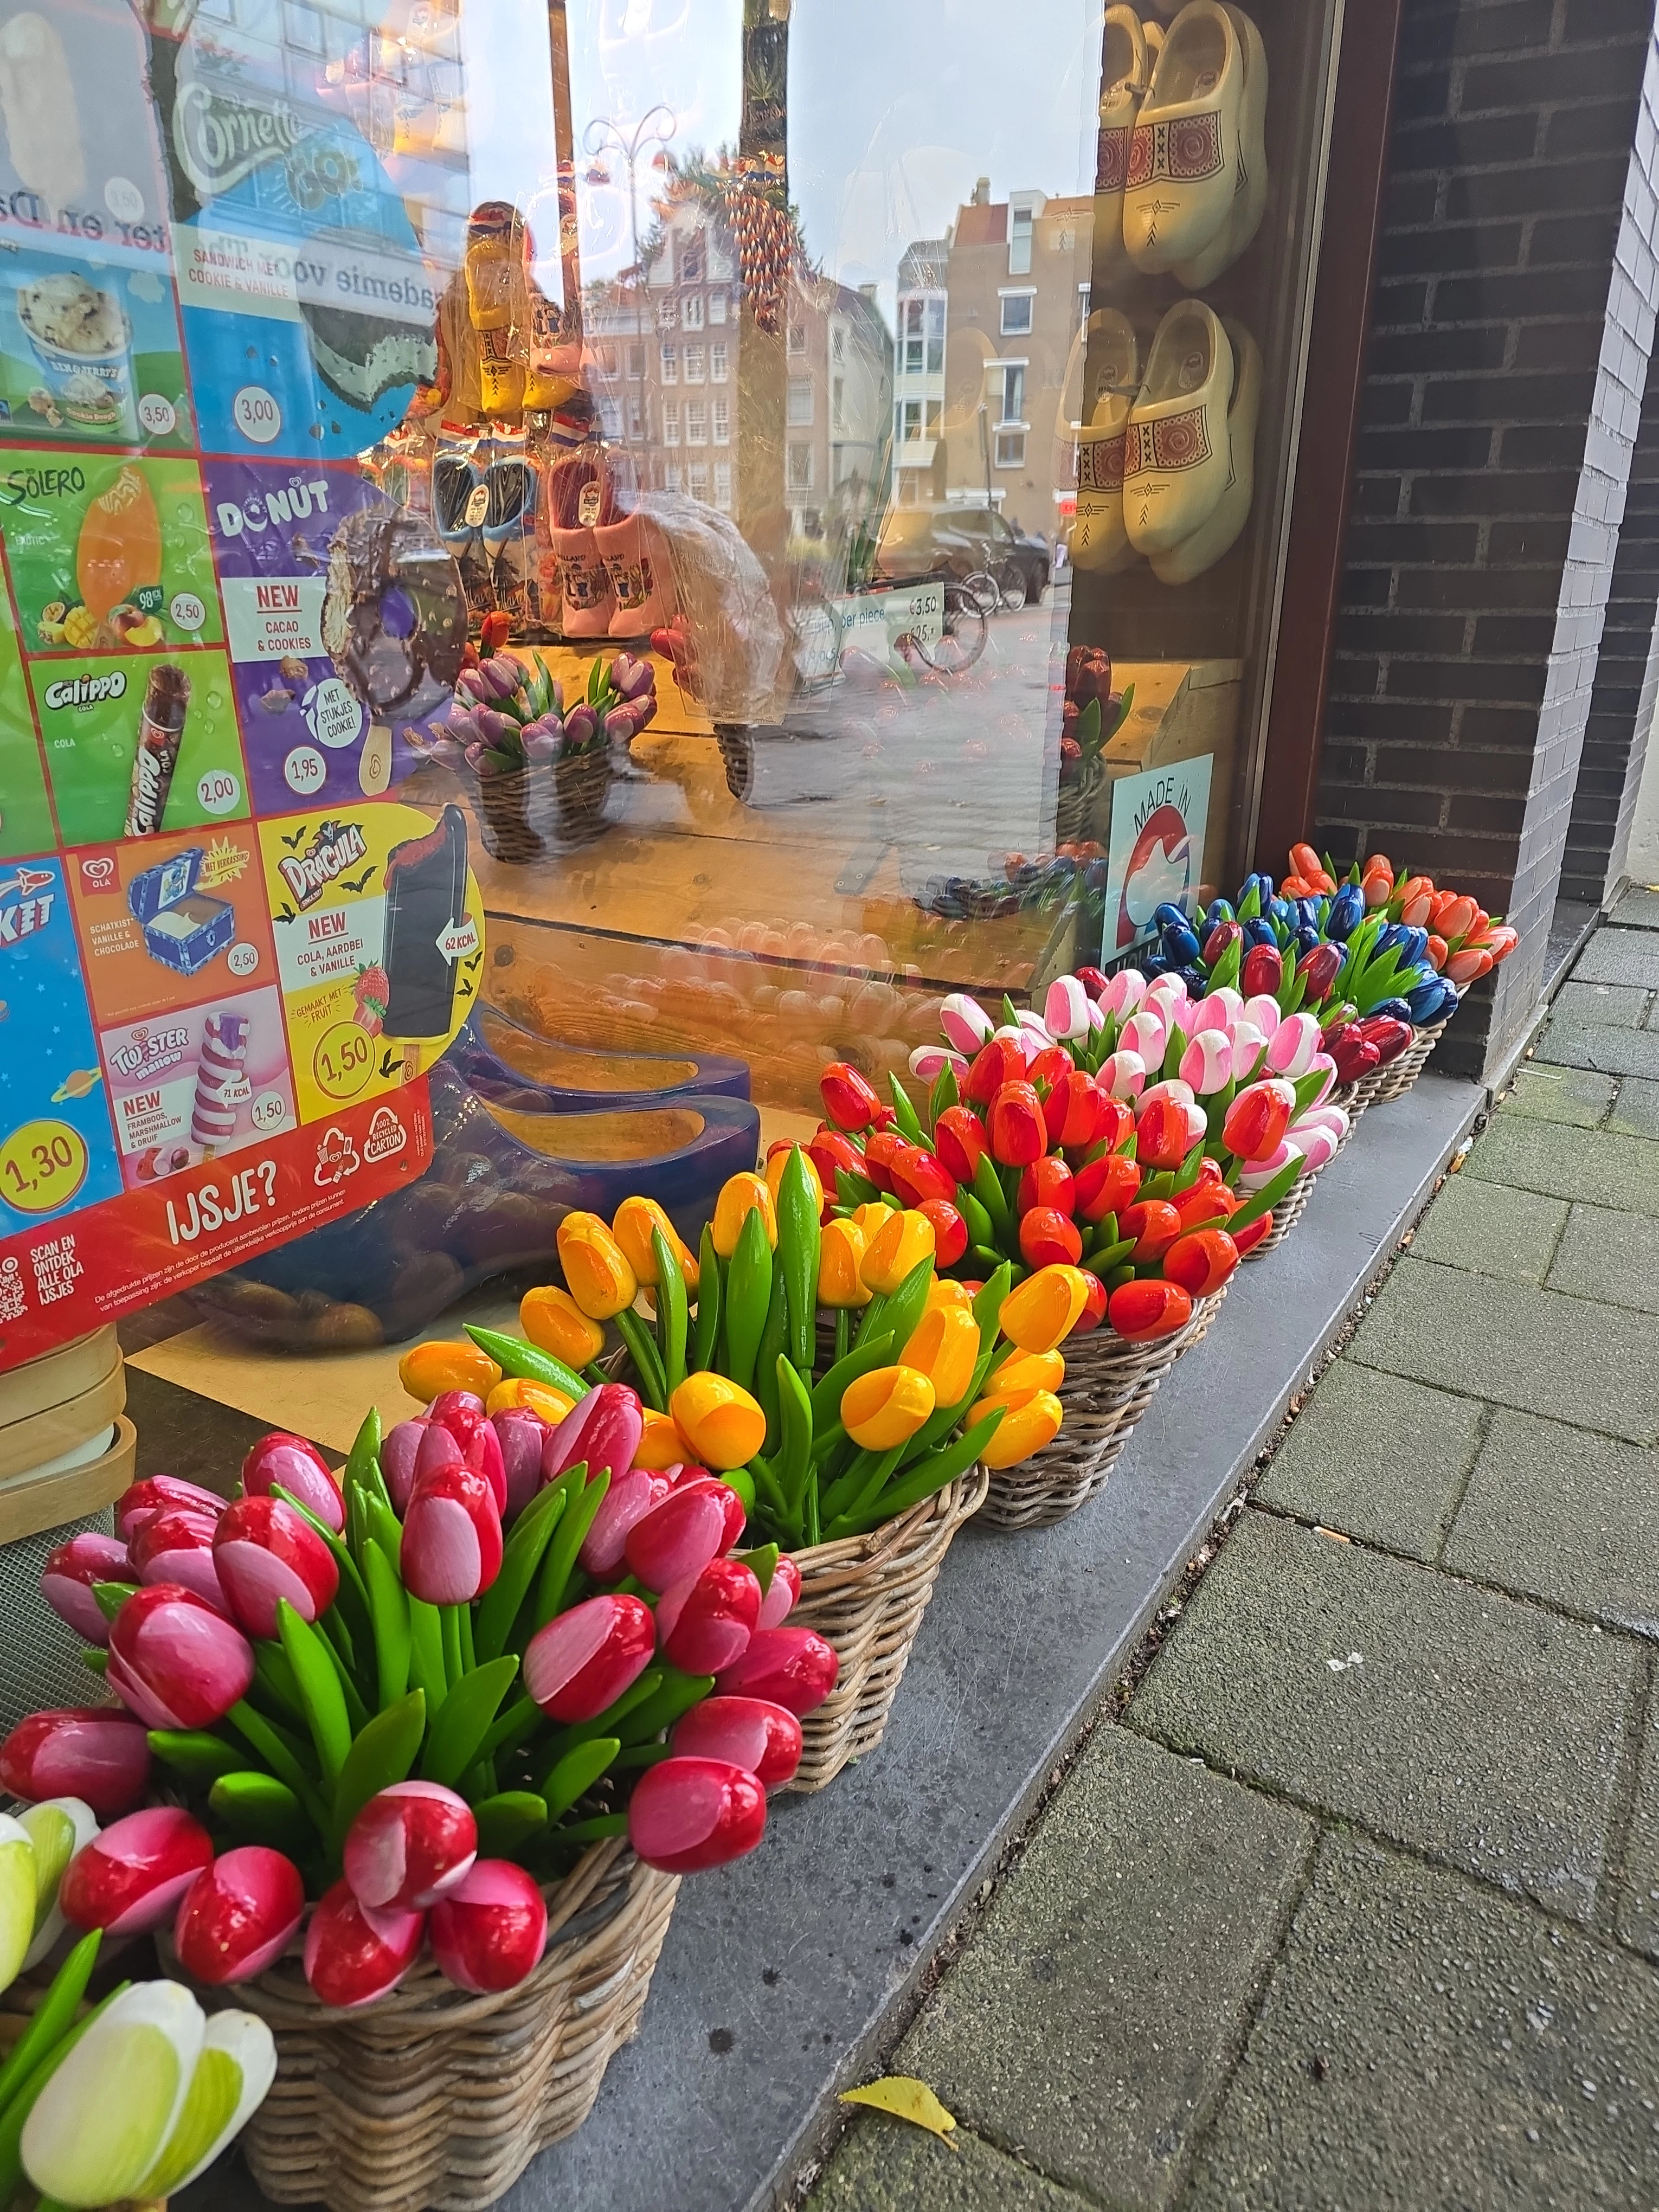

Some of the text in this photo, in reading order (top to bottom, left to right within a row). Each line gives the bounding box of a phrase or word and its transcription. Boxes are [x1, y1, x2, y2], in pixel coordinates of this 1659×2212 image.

[194, 248, 253, 272] SANDWICH
[189, 268, 288, 298] COOKIE & VANILLE
[144, 407, 169, 423] 3,50
[242, 399, 273, 424] 3,00
[8, 466, 85, 505] SOLERO
[217, 480, 328, 537] DONUT
[139, 591, 153, 609] 98
[256, 585, 298, 607] NEW
[176, 603, 199, 620] 2,50
[859, 608, 884, 629] piece
[266, 621, 298, 633] CACAO
[258, 637, 311, 651] & COOKIES
[78, 704, 93, 712] COLA
[324, 689, 339, 705] MET
[320, 700, 352, 724] STUKJES
[327, 716, 356, 738] COOKIE!
[54, 738, 75, 749] COLA
[160, 750, 172, 774] COLA
[292, 758, 318, 782] 1,95
[201, 777, 234, 803] 2,00
[1134, 777, 1191, 836] MADE IN
[205, 852, 248, 873] MET VERRASSING
[281, 824, 366, 898] DRACULA
[92, 879, 111, 889] OLA
[308, 911, 346, 939] NEW
[92, 930, 131, 946] VANILLE &
[94, 940, 139, 957] CHOCOLADE
[446, 932, 476, 950] 62 KCAL
[234, 952, 255, 968] 2,50
[298, 938, 363, 966] COLA, AARDBEI
[311, 955, 355, 976] & VANILLE
[297, 988, 342, 1018] GEMAAKT MET
[311, 1004, 332, 1023] FRUIT
[136, 1051, 182, 1080] mallow
[321, 1036, 368, 1081] 1,50
[123, 1090, 160, 1117] NEW
[224, 1086, 249, 1098] 71 KCAL
[127, 1112, 167, 1130] FRAMBOOS,
[255, 1101, 282, 1122] 1,50
[129, 1116, 182, 1140] MARSHMALLOW
[372, 1124, 397, 1141] RECYCLED
[376, 1118, 390, 1130] 100%
[138, 1134, 158, 1147] DRUIF
[370, 1132, 401, 1155] CARTON
[5, 1136, 73, 1192] 1,30
[166, 1160, 276, 1245] IJSJE?
[30, 1234, 76, 1263] SCAN EN
[94, 1295, 105, 1303] De
[106, 1279, 141, 1299] afgedrukte
[142, 1270, 163, 1284] prijzen
[164, 1265, 175, 1274] zijn
[176, 1260, 184, 1269] de
[185, 1253, 200, 1264] door
[200, 1250, 209, 1258] de
[209, 1237, 239, 1255] producent
[239, 1222, 271, 1241] aanbevolen
[292, 1205, 310, 1217] Andere
[311, 1198, 327, 1210] prijzen
[327, 1189, 346, 1201] kunnen
[34, 1249, 76, 1277] ONTDEK
[100, 1303, 113, 1312] van
[113, 1287, 149, 1306] toepassing
[163, 1276, 172, 1284] de
[173, 1264, 200, 1280] verkoper
[200, 1253, 223, 1268] bepaalt
[223, 1250, 232, 1258] de
[232, 1236, 264, 1253] uiteindelijke
[265, 1220, 297, 1239] verkoopprijs
[298, 1216, 307, 1224] aan
[38, 1261, 85, 1292] ALLE OLA
[39, 1280, 74, 1305] IJSJES
